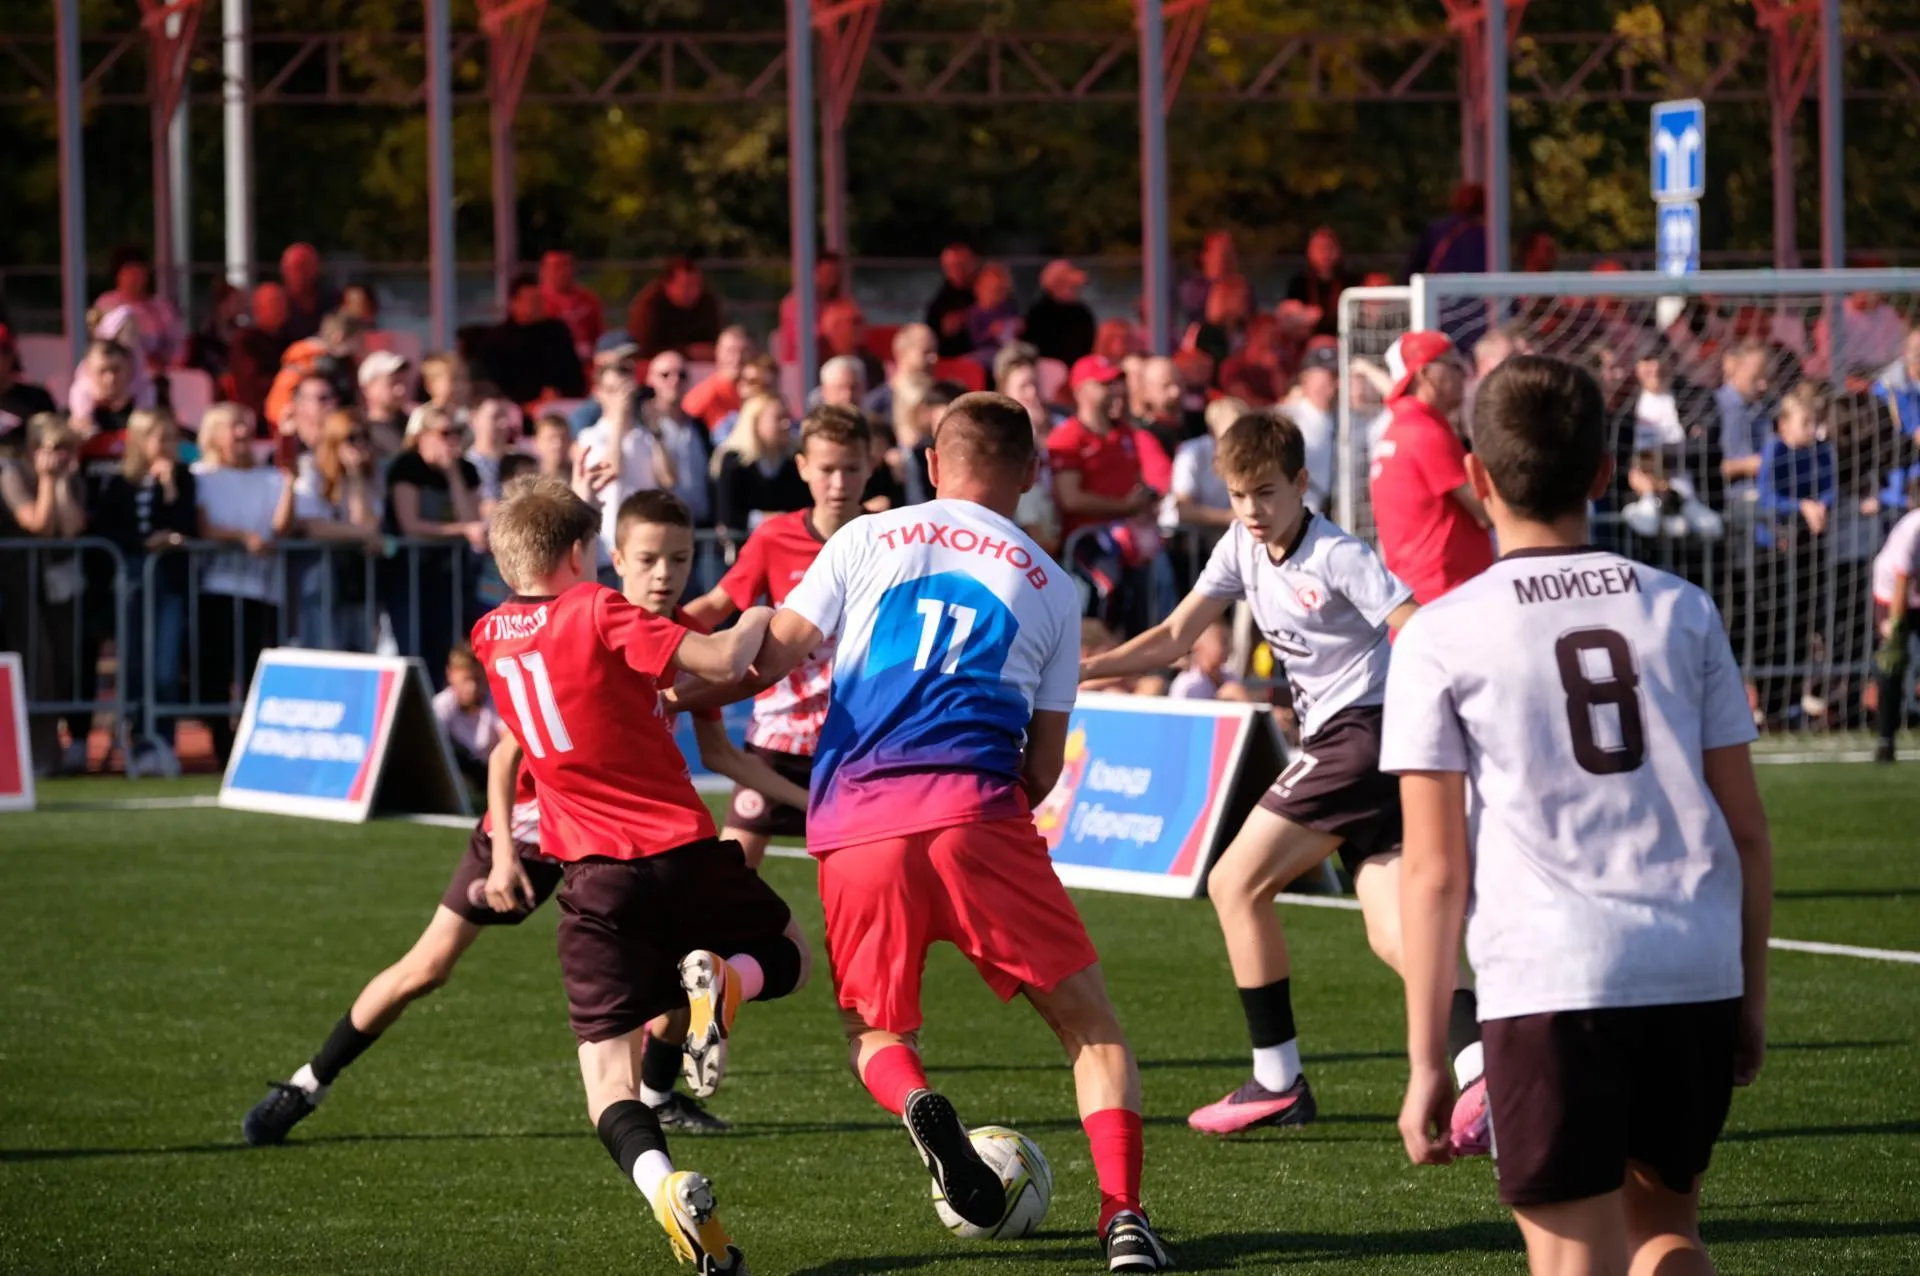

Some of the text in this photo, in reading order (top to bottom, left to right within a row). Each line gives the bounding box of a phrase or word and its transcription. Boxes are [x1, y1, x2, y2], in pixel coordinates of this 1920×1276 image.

[878, 522, 1048, 590] ТИХОНОВ
[1512, 563, 1642, 604] МОЙСЕЙ
[913, 597, 978, 675] 11
[495, 650, 574, 759] 11
[1555, 625, 1647, 775] 8
